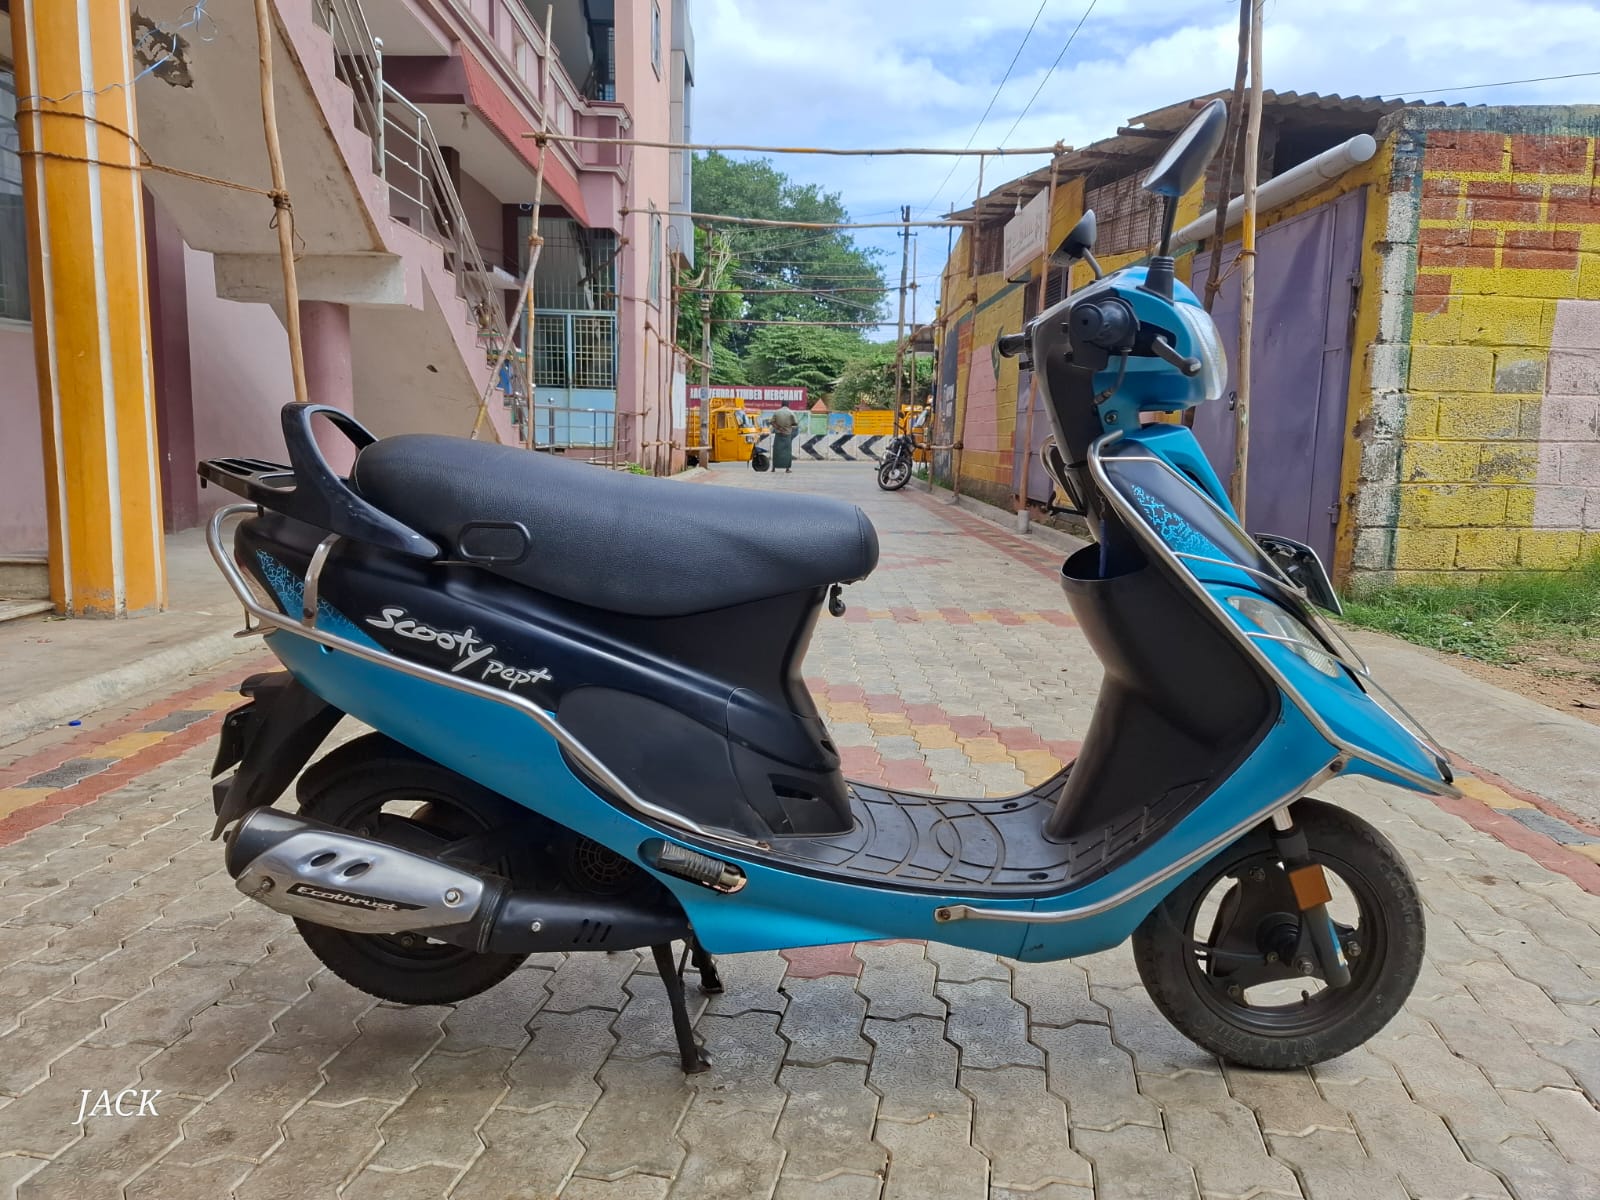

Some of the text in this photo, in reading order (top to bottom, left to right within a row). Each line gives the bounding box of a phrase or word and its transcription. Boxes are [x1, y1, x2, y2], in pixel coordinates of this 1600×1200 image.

[735, 388, 763, 400] TIMBER
[764, 389, 804, 401] MERCHANT
[365, 608, 494, 672] Scooty
[296, 885, 399, 911] Ecothrust
